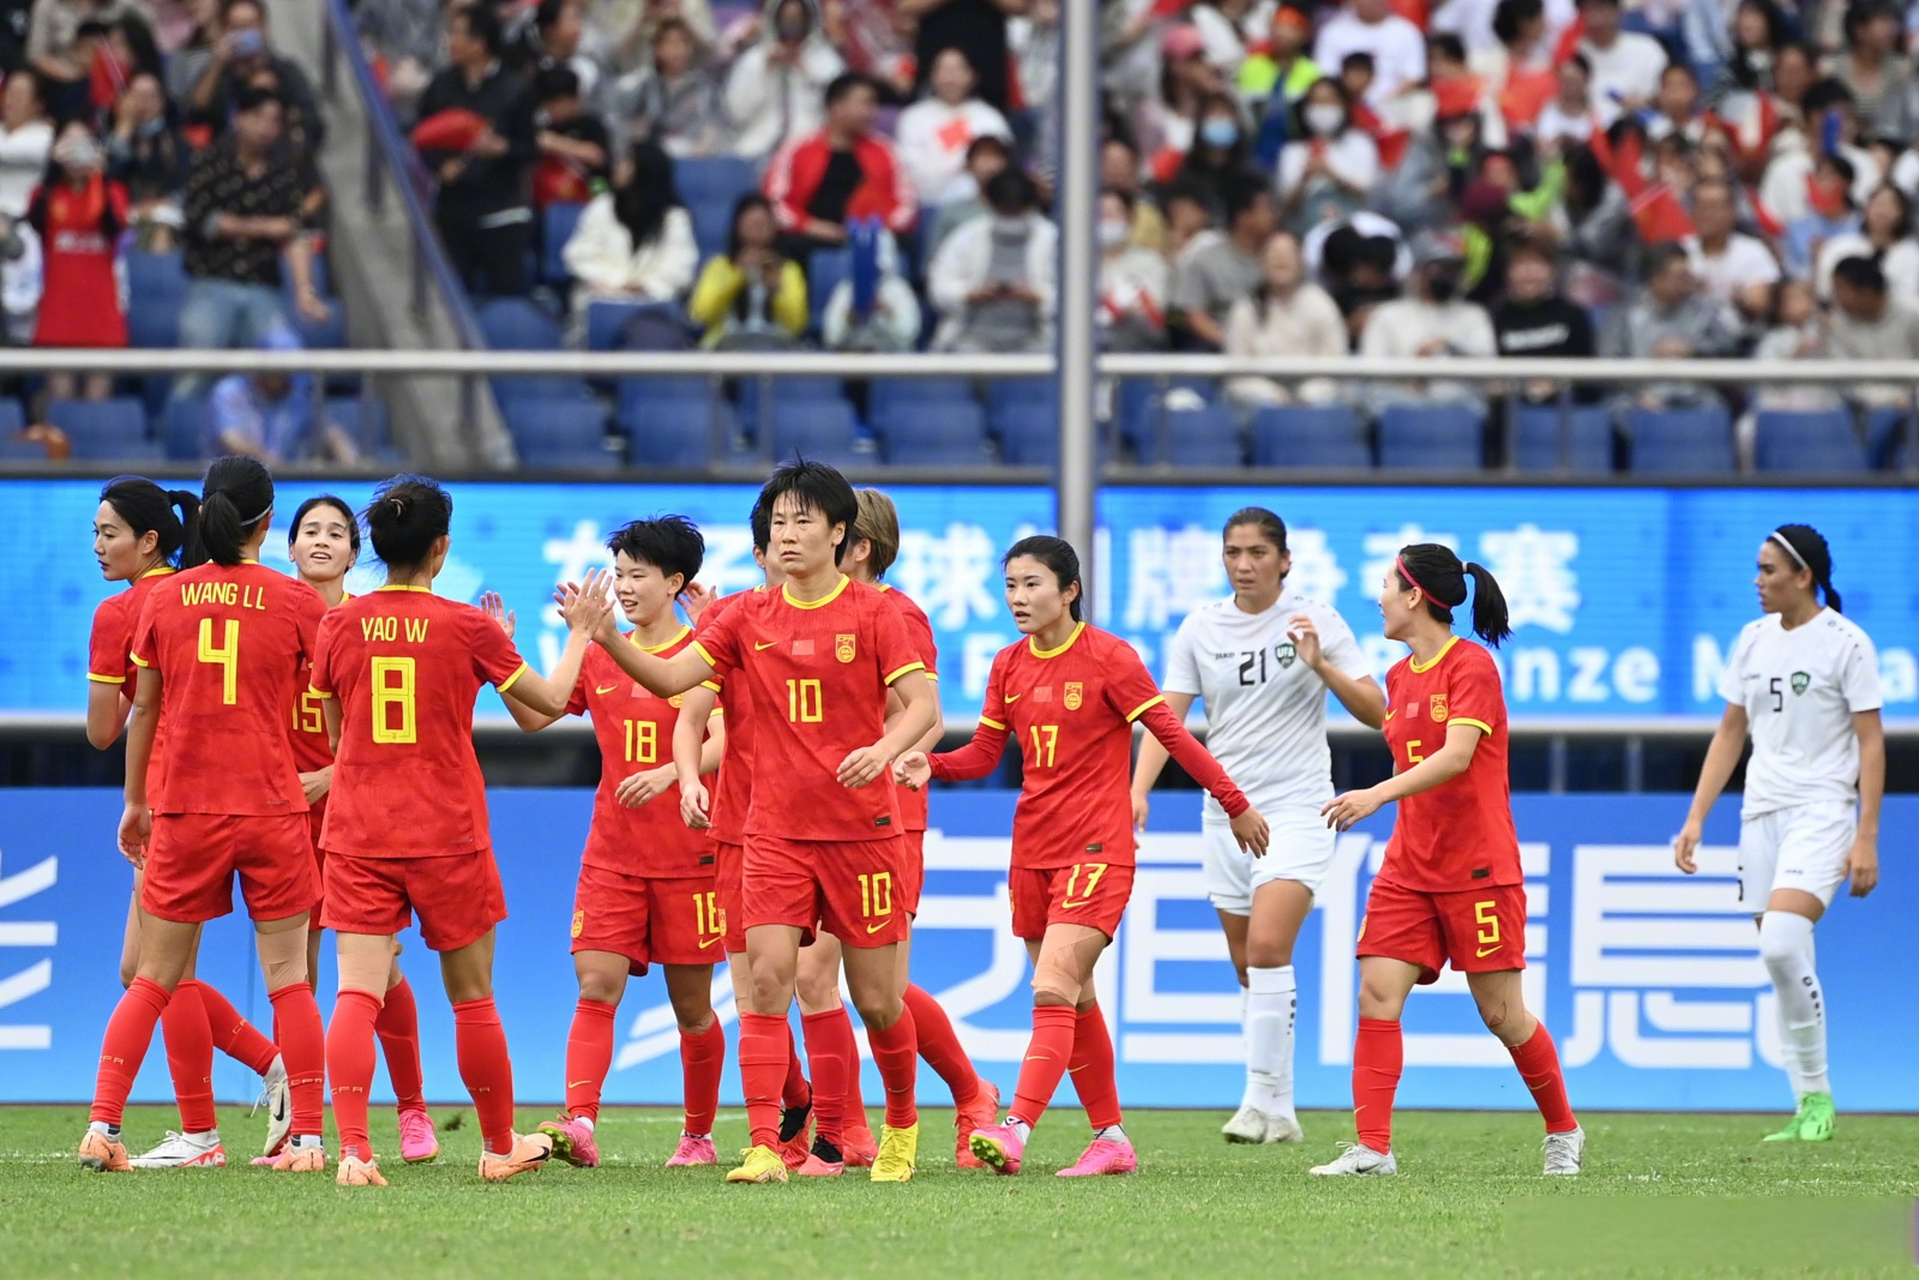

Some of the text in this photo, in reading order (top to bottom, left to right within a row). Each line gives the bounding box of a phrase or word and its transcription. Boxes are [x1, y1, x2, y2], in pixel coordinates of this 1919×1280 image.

[181, 581, 238, 607] WANG
[361, 616, 429, 643] YAO W
[198, 618, 240, 705] 4
[1239, 647, 1267, 687] 21
[1276, 646, 1295, 659] UFA
[1359, 634, 1662, 702] Bnze
[371, 656, 417, 744] 8
[786, 678, 823, 723] 10
[1770, 677, 1783, 713] 5
[623, 719, 657, 763] 18
[1030, 725, 1059, 768] 17
[858, 871, 892, 917] 10
[1066, 863, 1108, 898] 17
[1474, 900, 1500, 943] 5
[331, 1086, 363, 1095] CFA
